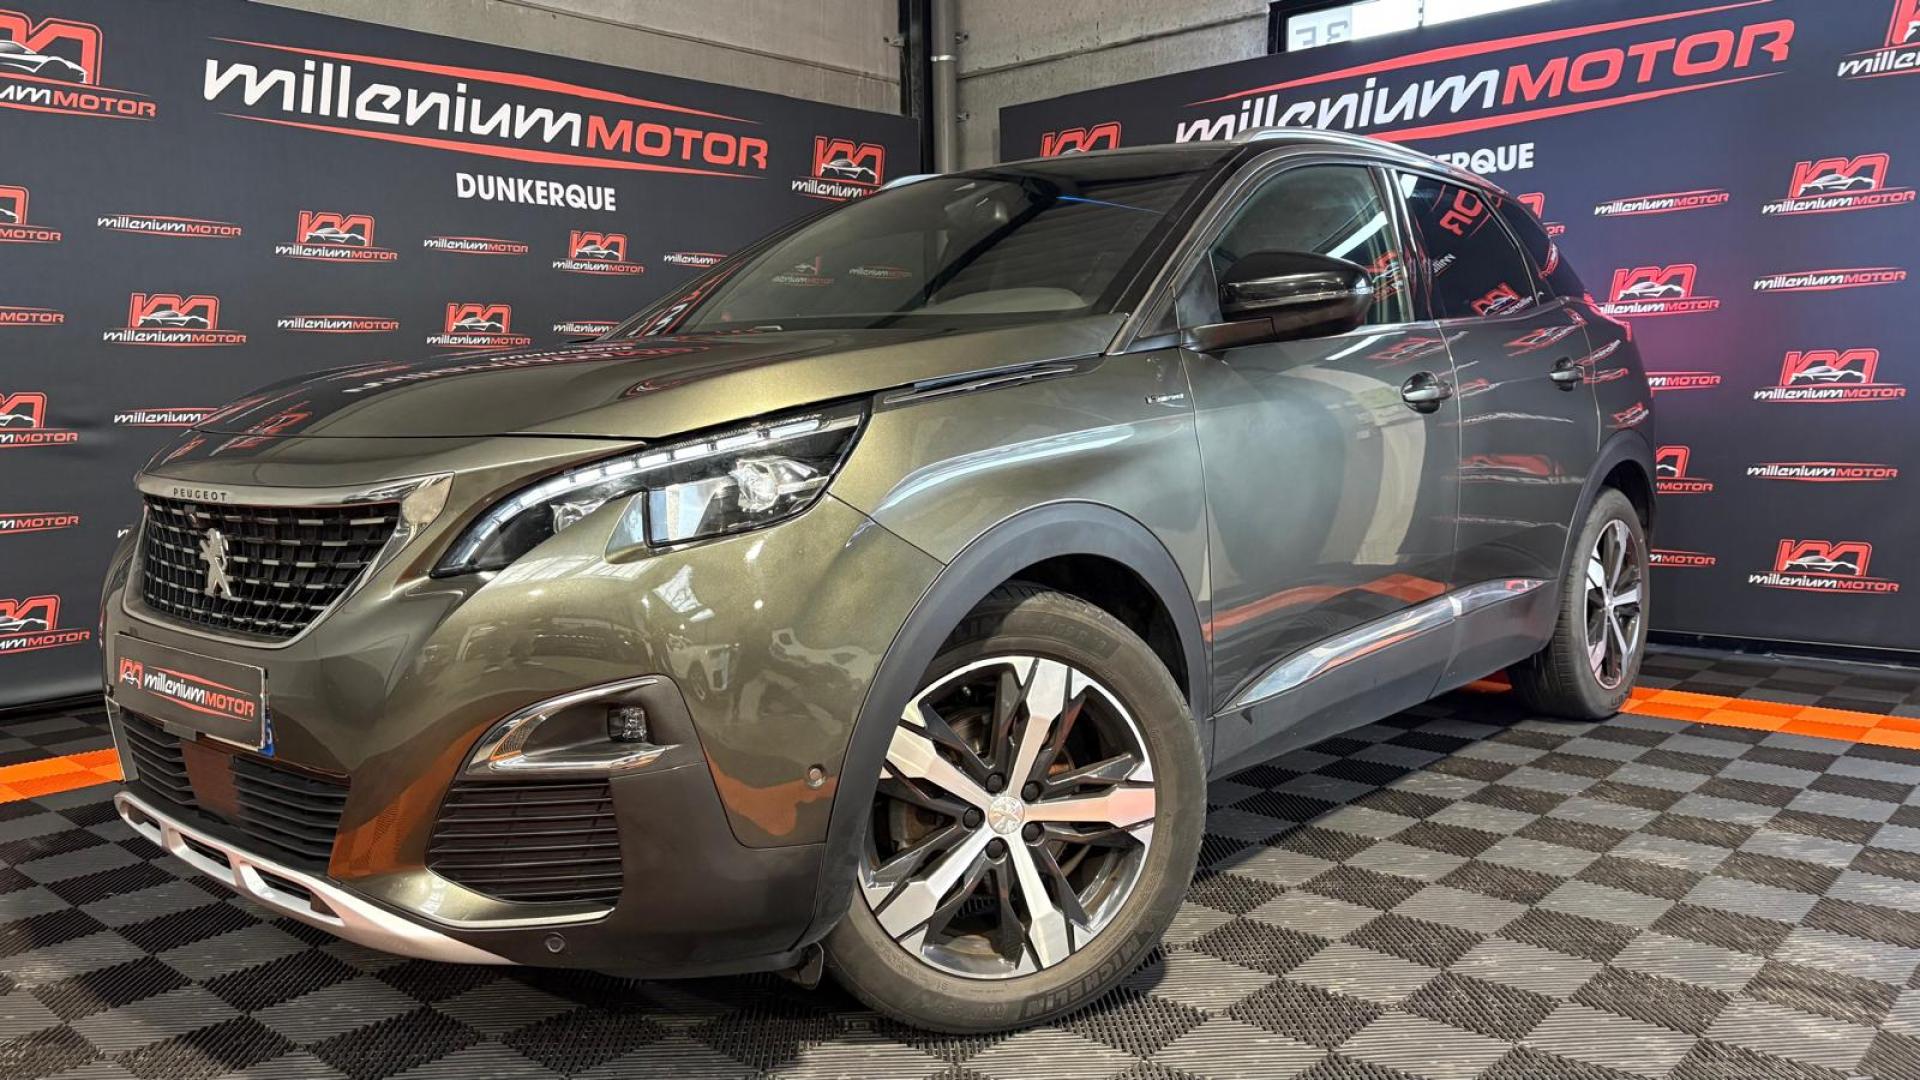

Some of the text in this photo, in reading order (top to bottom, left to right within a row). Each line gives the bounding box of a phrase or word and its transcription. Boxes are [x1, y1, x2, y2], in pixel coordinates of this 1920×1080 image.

[204, 58, 769, 171] milleniumMOTOR
[455, 172, 617, 212] DUNKERQUE
[173, 487, 227, 501] PEUGEOT
[1026, 933, 1145, 1019] MICHELIN
